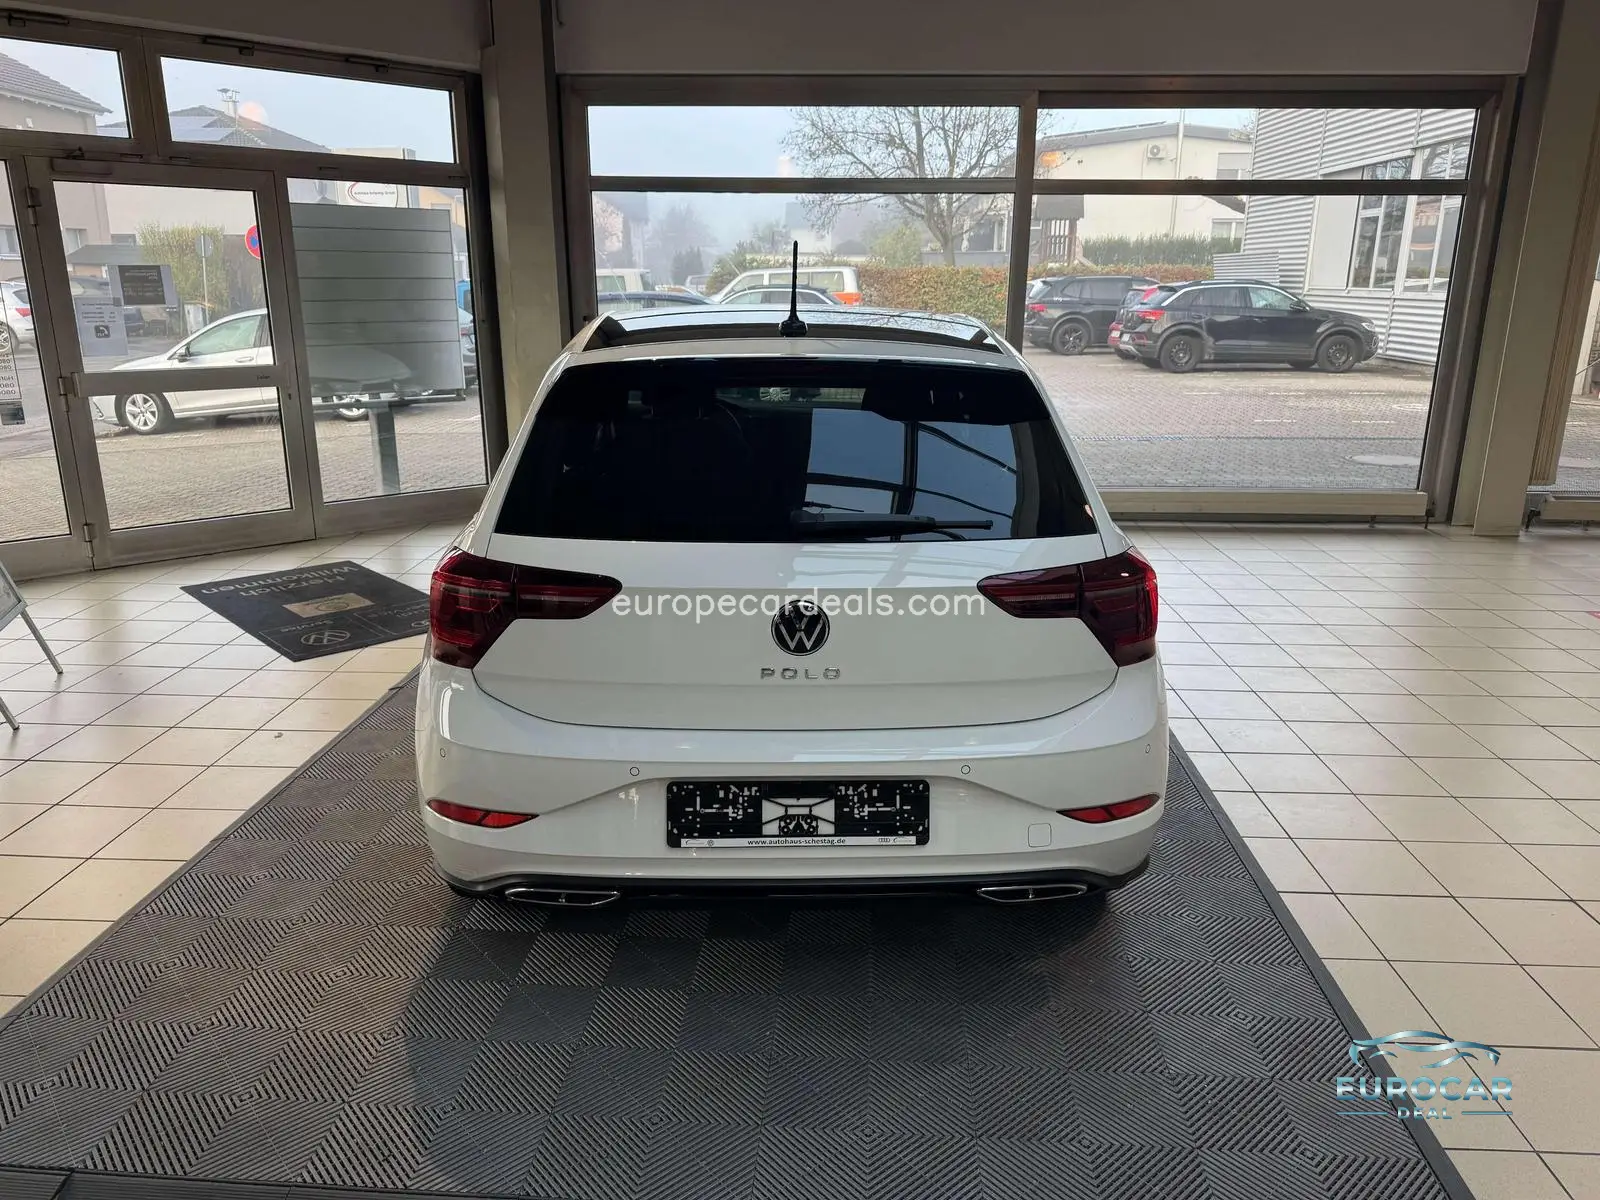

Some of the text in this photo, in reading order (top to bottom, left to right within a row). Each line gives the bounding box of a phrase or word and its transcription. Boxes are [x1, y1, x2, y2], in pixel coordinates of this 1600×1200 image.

[240, 575, 346, 597] Herzlich
[760, 667, 842, 681] POLO
[747, 838, 846, 846] www.autohaus-schestag.de
